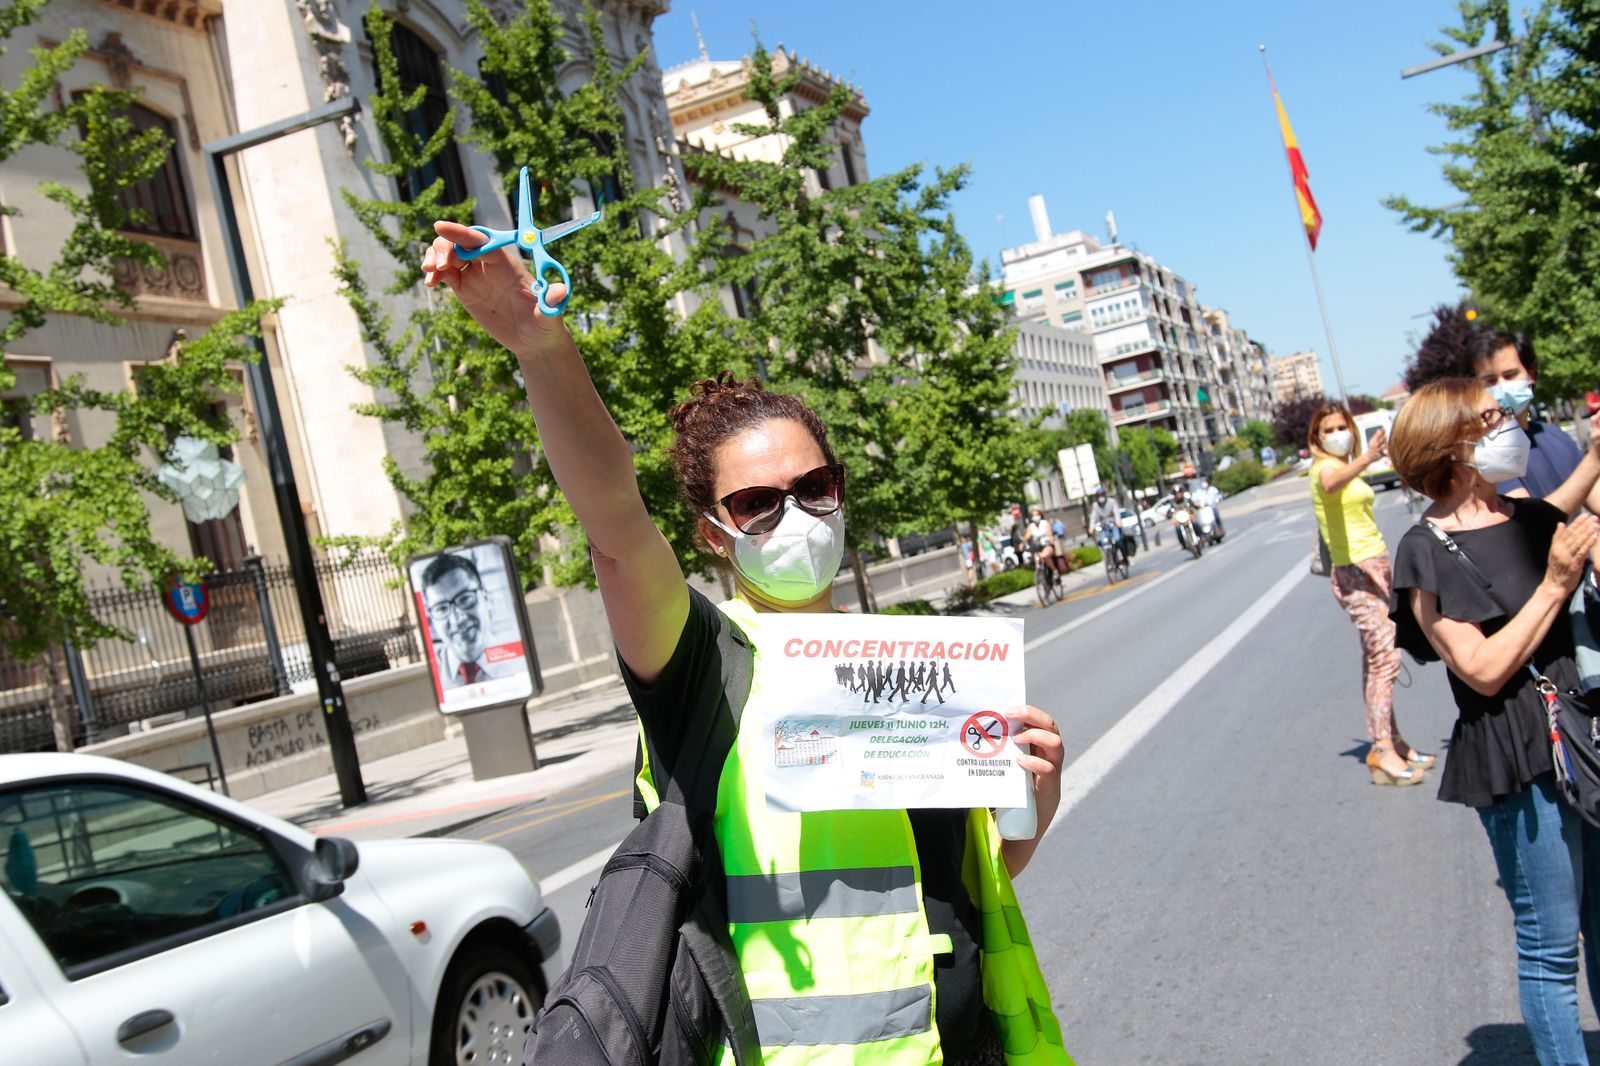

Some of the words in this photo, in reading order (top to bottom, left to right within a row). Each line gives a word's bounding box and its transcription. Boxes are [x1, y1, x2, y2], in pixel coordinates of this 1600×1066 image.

[783, 638, 1009, 662] CONCENTRACIÓN
[849, 720, 885, 730] JUEVES
[896, 720, 927, 730] JUNIO
[929, 720, 949, 729] 12H.
[248, 718, 291, 749] BASTA
[869, 735, 928, 744] DELEGACIÓN
[863, 750, 876, 759] DE
[877, 749, 931, 759] EDUCACIÓN
[956, 758, 978, 766] CONTRA
[968, 769, 975, 777] EN
